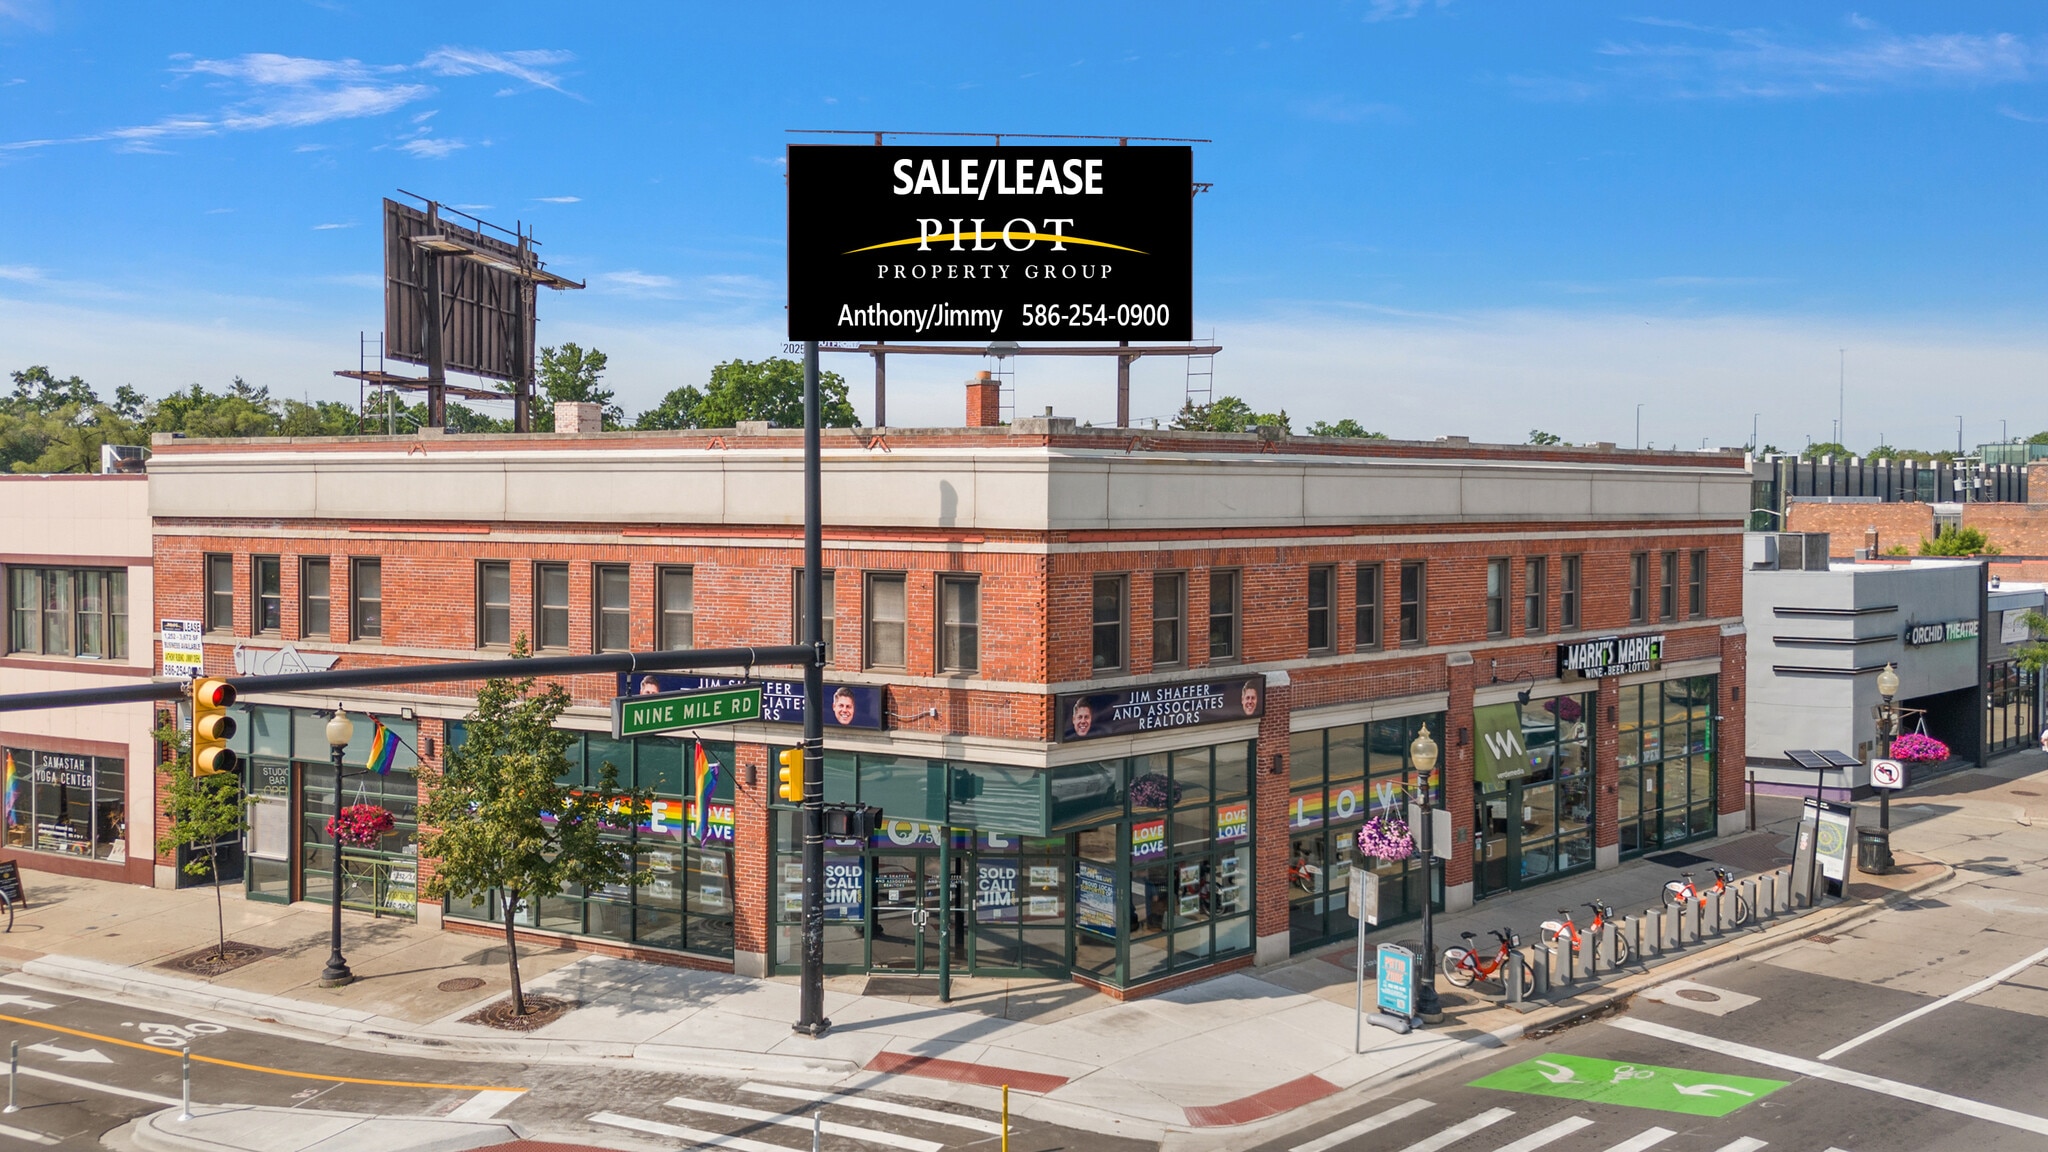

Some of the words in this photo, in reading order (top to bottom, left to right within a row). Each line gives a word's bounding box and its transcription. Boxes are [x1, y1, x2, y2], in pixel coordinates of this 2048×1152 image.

[893, 158, 1104, 200] SALE/LEASE
[916, 218, 1075, 252] PILOT
[877, 264, 1010, 279] PROPERTY
[1025, 264, 1114, 279] GROUP
[837, 303, 1003, 332] Anthony/Jimmy
[1022, 304, 1170, 326] 586-254-0900
[184, 622, 200, 632] LEASE
[1912, 624, 1943, 645] ORCHID
[1946, 621, 1979, 640] THEATRE
[1618, 636, 1665, 664] MARKET
[1585, 667, 1603, 679] WINE
[1608, 664, 1625, 676] BEER
[1628, 661, 1650, 673] LOTTO
[1129, 691, 1150, 704] JIM
[1156, 684, 1210, 700] SHAFFER
[633, 706, 673, 726] NINE
[683, 701, 722, 719] MILE
[731, 697, 751, 714] RD
[1113, 706, 1141, 721] AND
[1147, 697, 1224, 717] ASSOCIATES
[1138, 711, 1200, 730] REALTORS
[43, 755, 85, 771] SAMASTAH
[36, 770, 57, 783] YOGA
[60, 773, 92, 787] CENTER
[269, 776, 286, 785] BAR
[1297, 775, 1422, 827] LOV
[691, 804, 731, 821] LVE
[1219, 809, 1247, 824] LOVE
[1134, 825, 1164, 841] LOVE
[1219, 823, 1247, 838] LOVE
[1134, 840, 1164, 857] LOVE
[825, 865, 862, 878] SOLD
[979, 867, 1016, 879] SOLD
[825, 877, 862, 889] CALL
[979, 879, 1015, 892] CALL
[825, 889, 857, 904] JIM
[979, 891, 1011, 906] JIM
